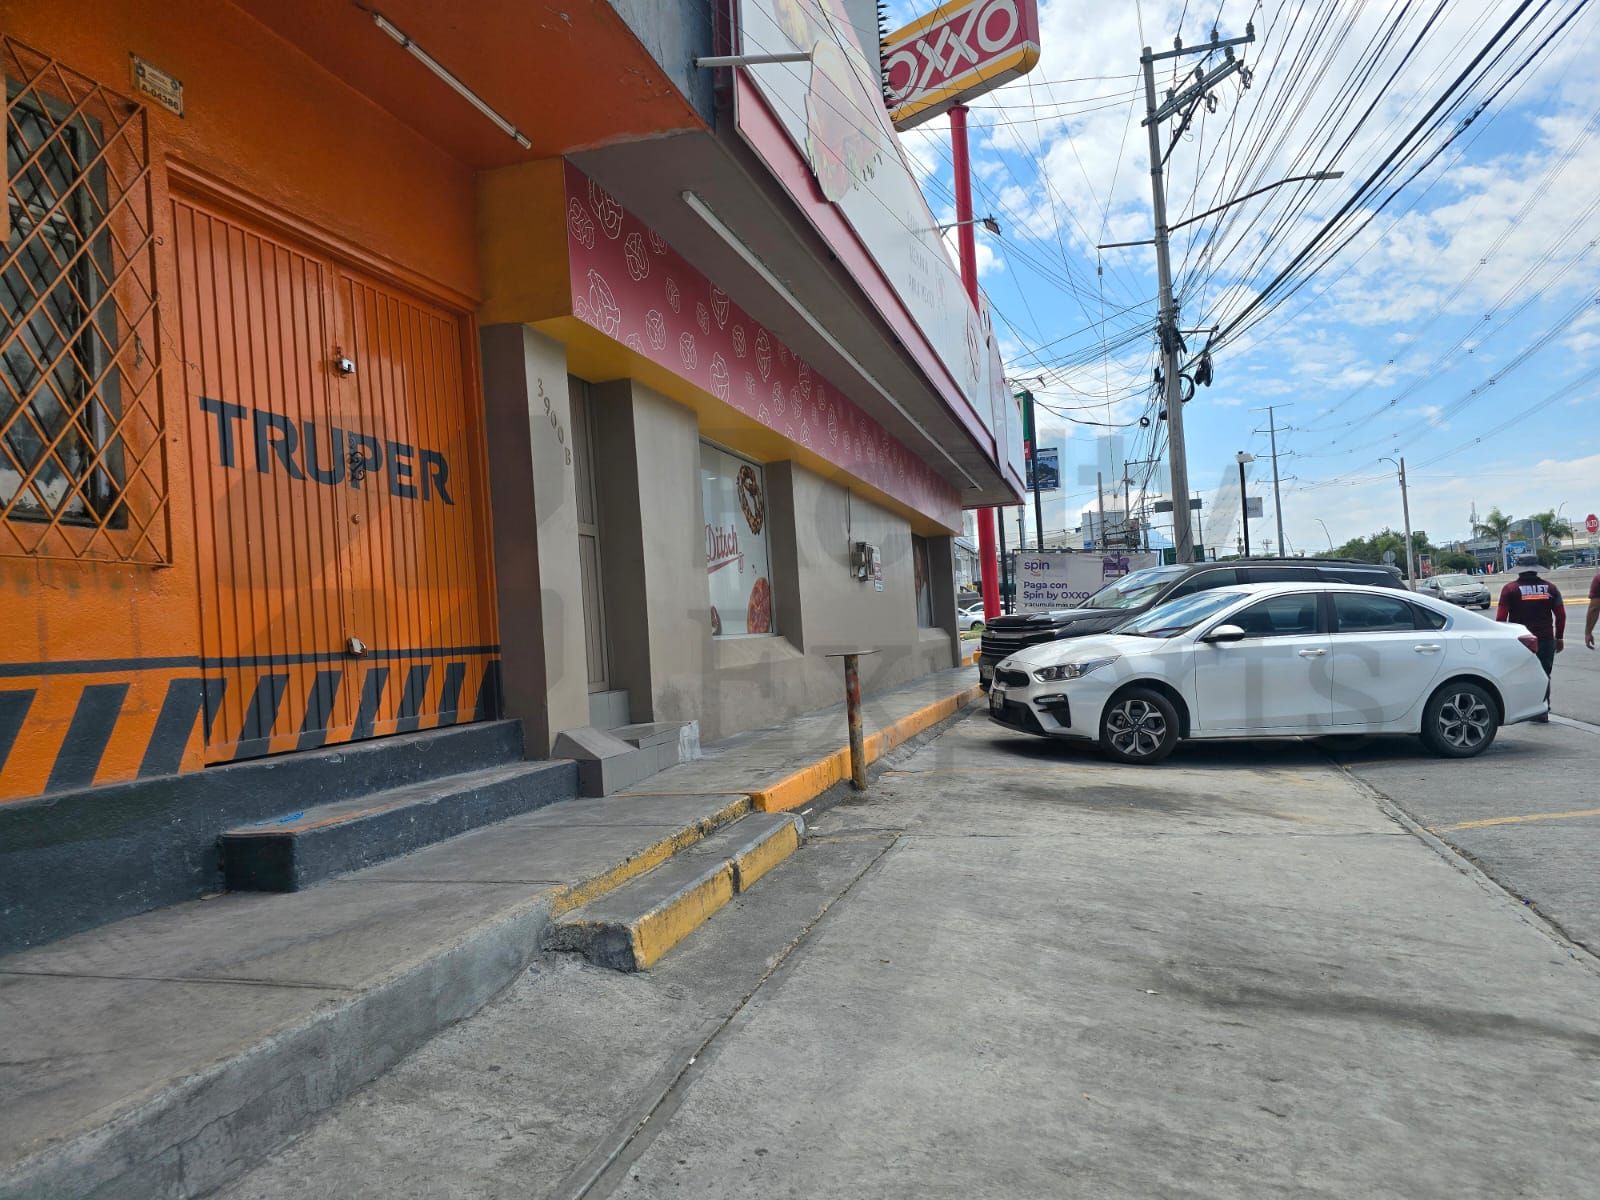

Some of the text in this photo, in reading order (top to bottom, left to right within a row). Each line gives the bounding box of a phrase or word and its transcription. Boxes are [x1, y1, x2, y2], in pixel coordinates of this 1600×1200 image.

[884, 0, 1019, 100] OXXO
[537, 378, 572, 466] 3900B
[199, 396, 456, 505] TRUPER
[705, 524, 738, 562] Ditsch
[1024, 559, 1050, 574] spin
[1024, 581, 1048, 591] Paga
[1024, 591, 1090, 601] Spin by OXXO
